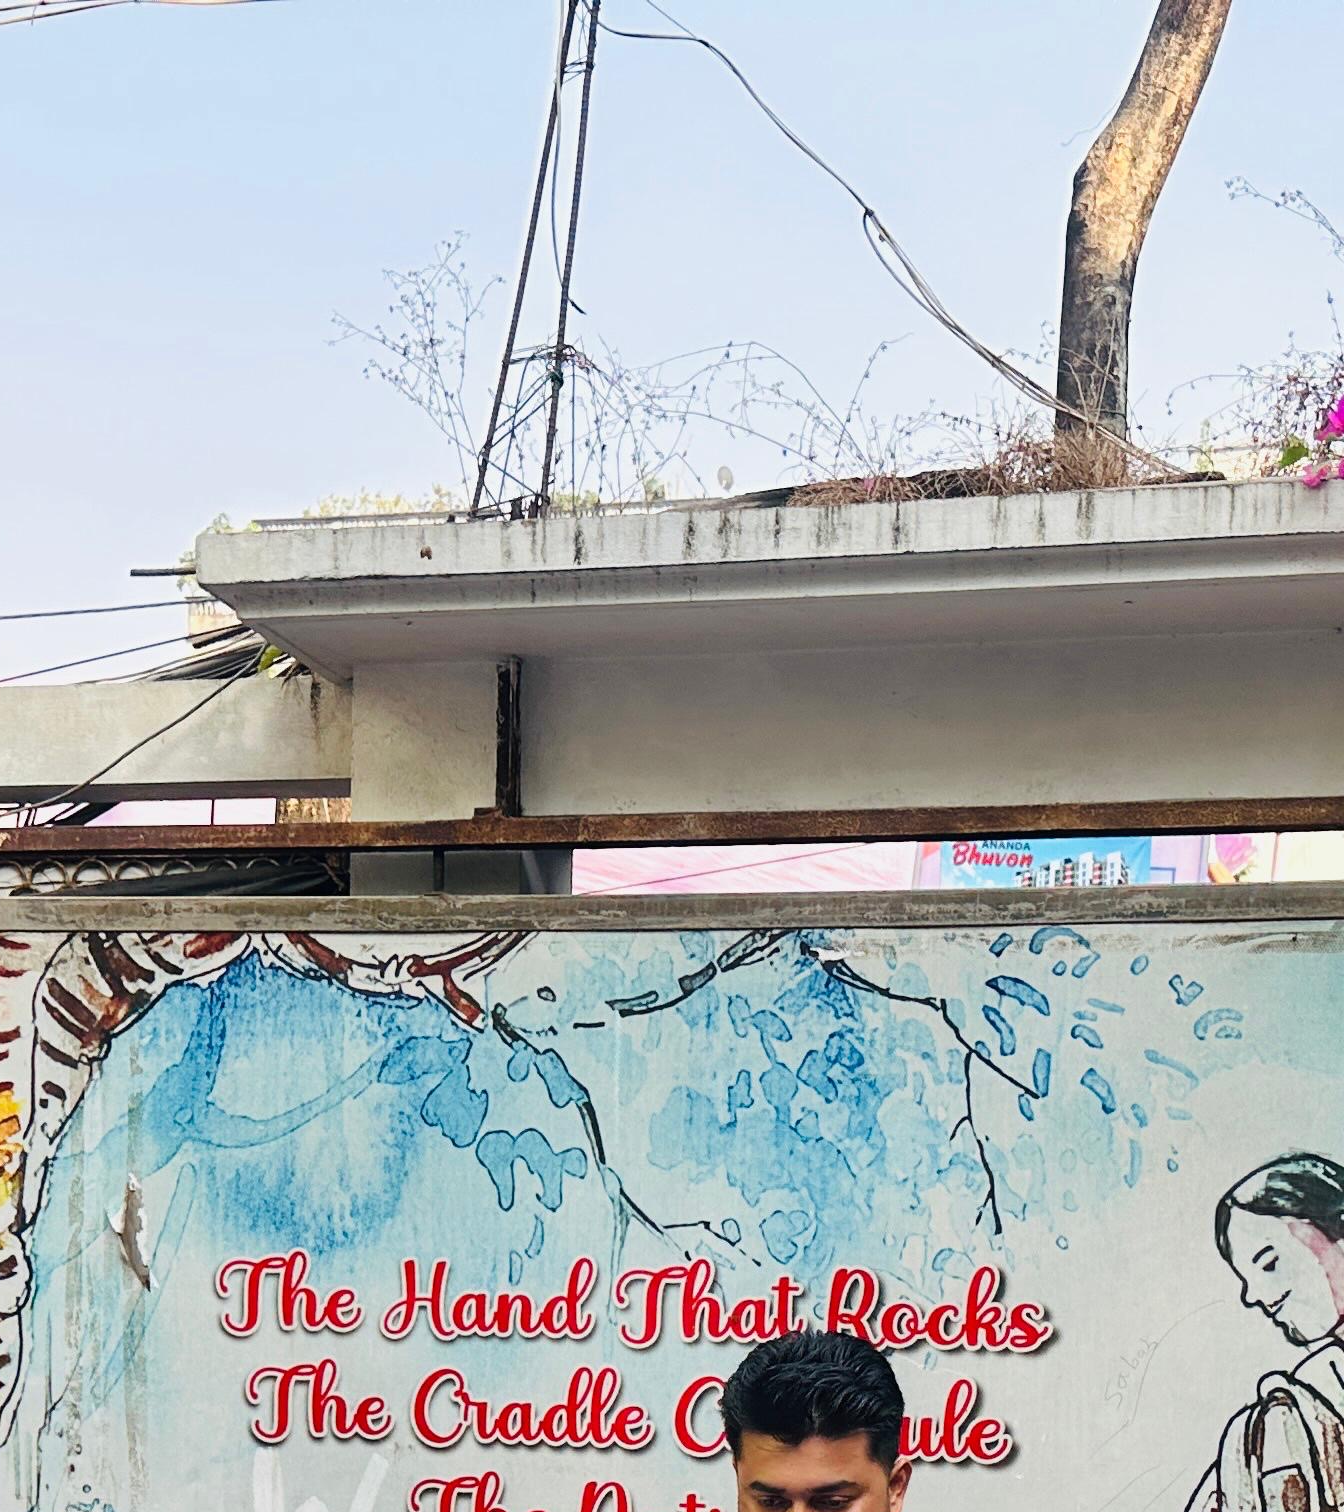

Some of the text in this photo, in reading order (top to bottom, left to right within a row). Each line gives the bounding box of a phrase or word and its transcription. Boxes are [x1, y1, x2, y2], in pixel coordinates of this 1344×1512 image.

[981, 840, 1031, 851] ANANDA
[216, 1252, 1053, 1353] The Hand That Rocks
[246, 1364, 393, 1445] The
[412, 1366, 655, 1454] Cradle
[896, 1377, 1013, 1465] ule
